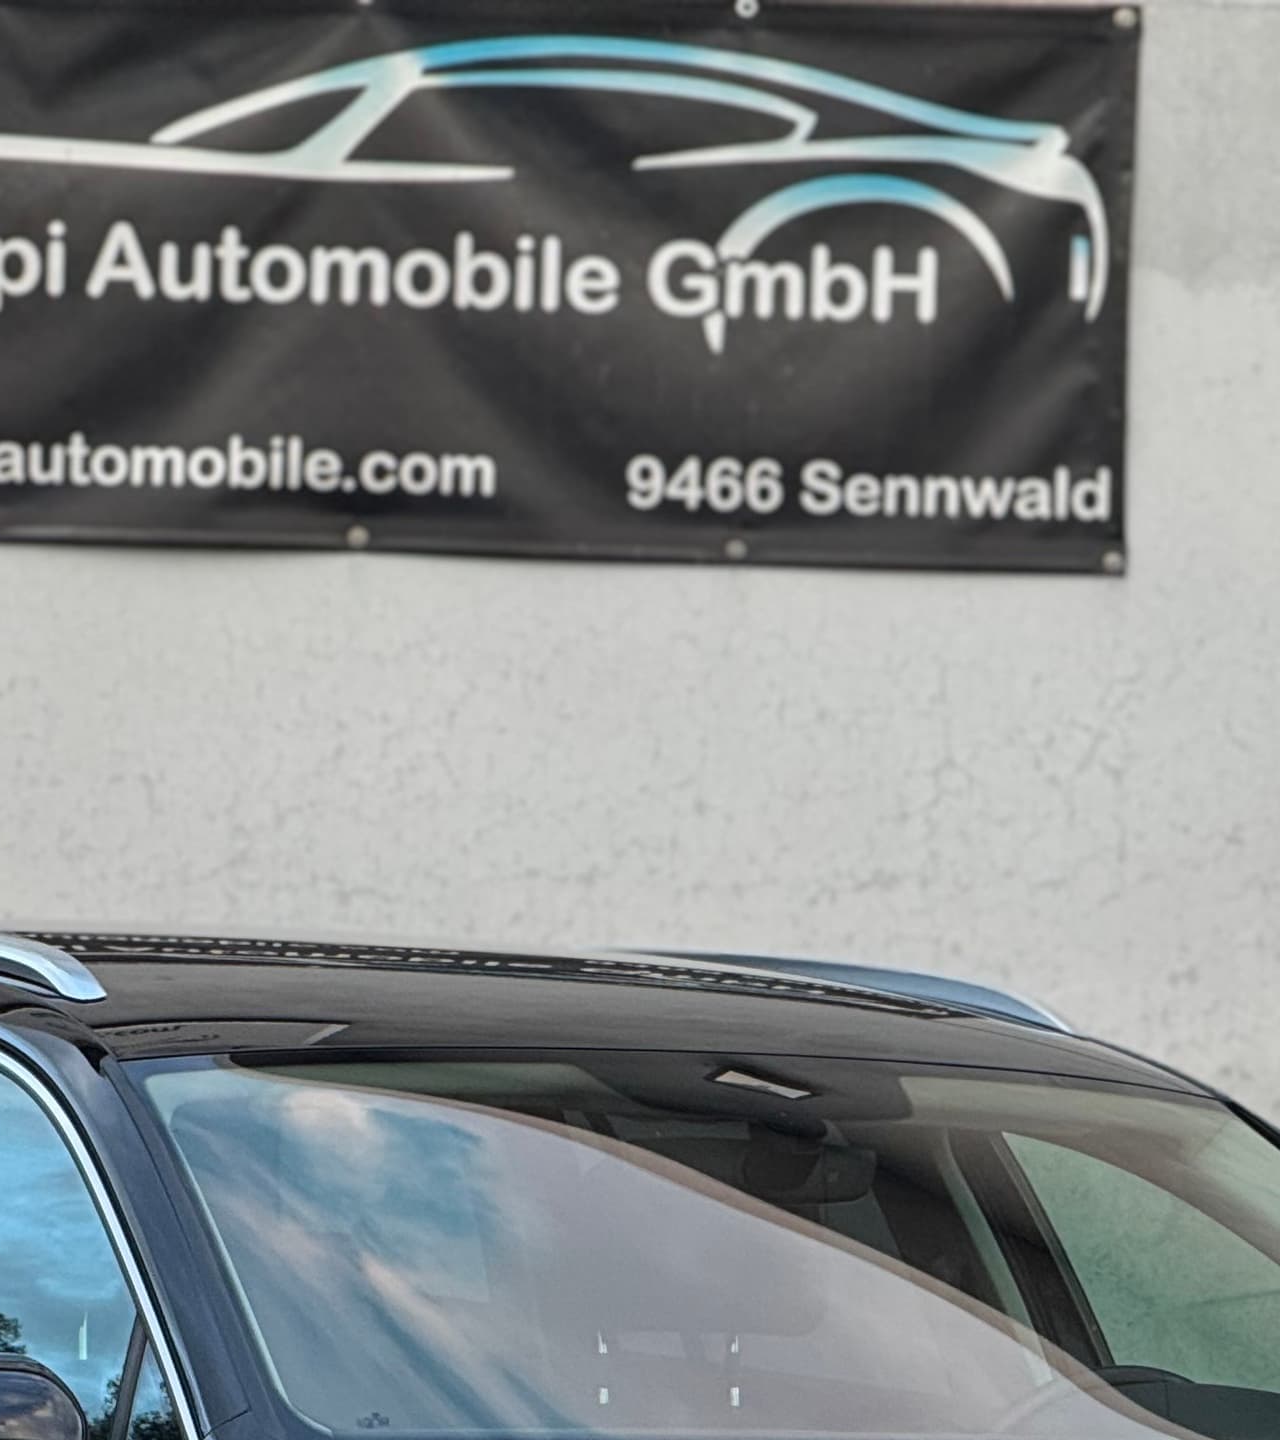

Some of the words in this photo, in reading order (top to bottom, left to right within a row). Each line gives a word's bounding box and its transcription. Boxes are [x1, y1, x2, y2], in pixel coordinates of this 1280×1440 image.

[86, 222, 620, 313] Automobile
[646, 240, 940, 325] GmbH
[624, 454, 783, 513] 9466
[798, 459, 1113, 522] Sennwald
